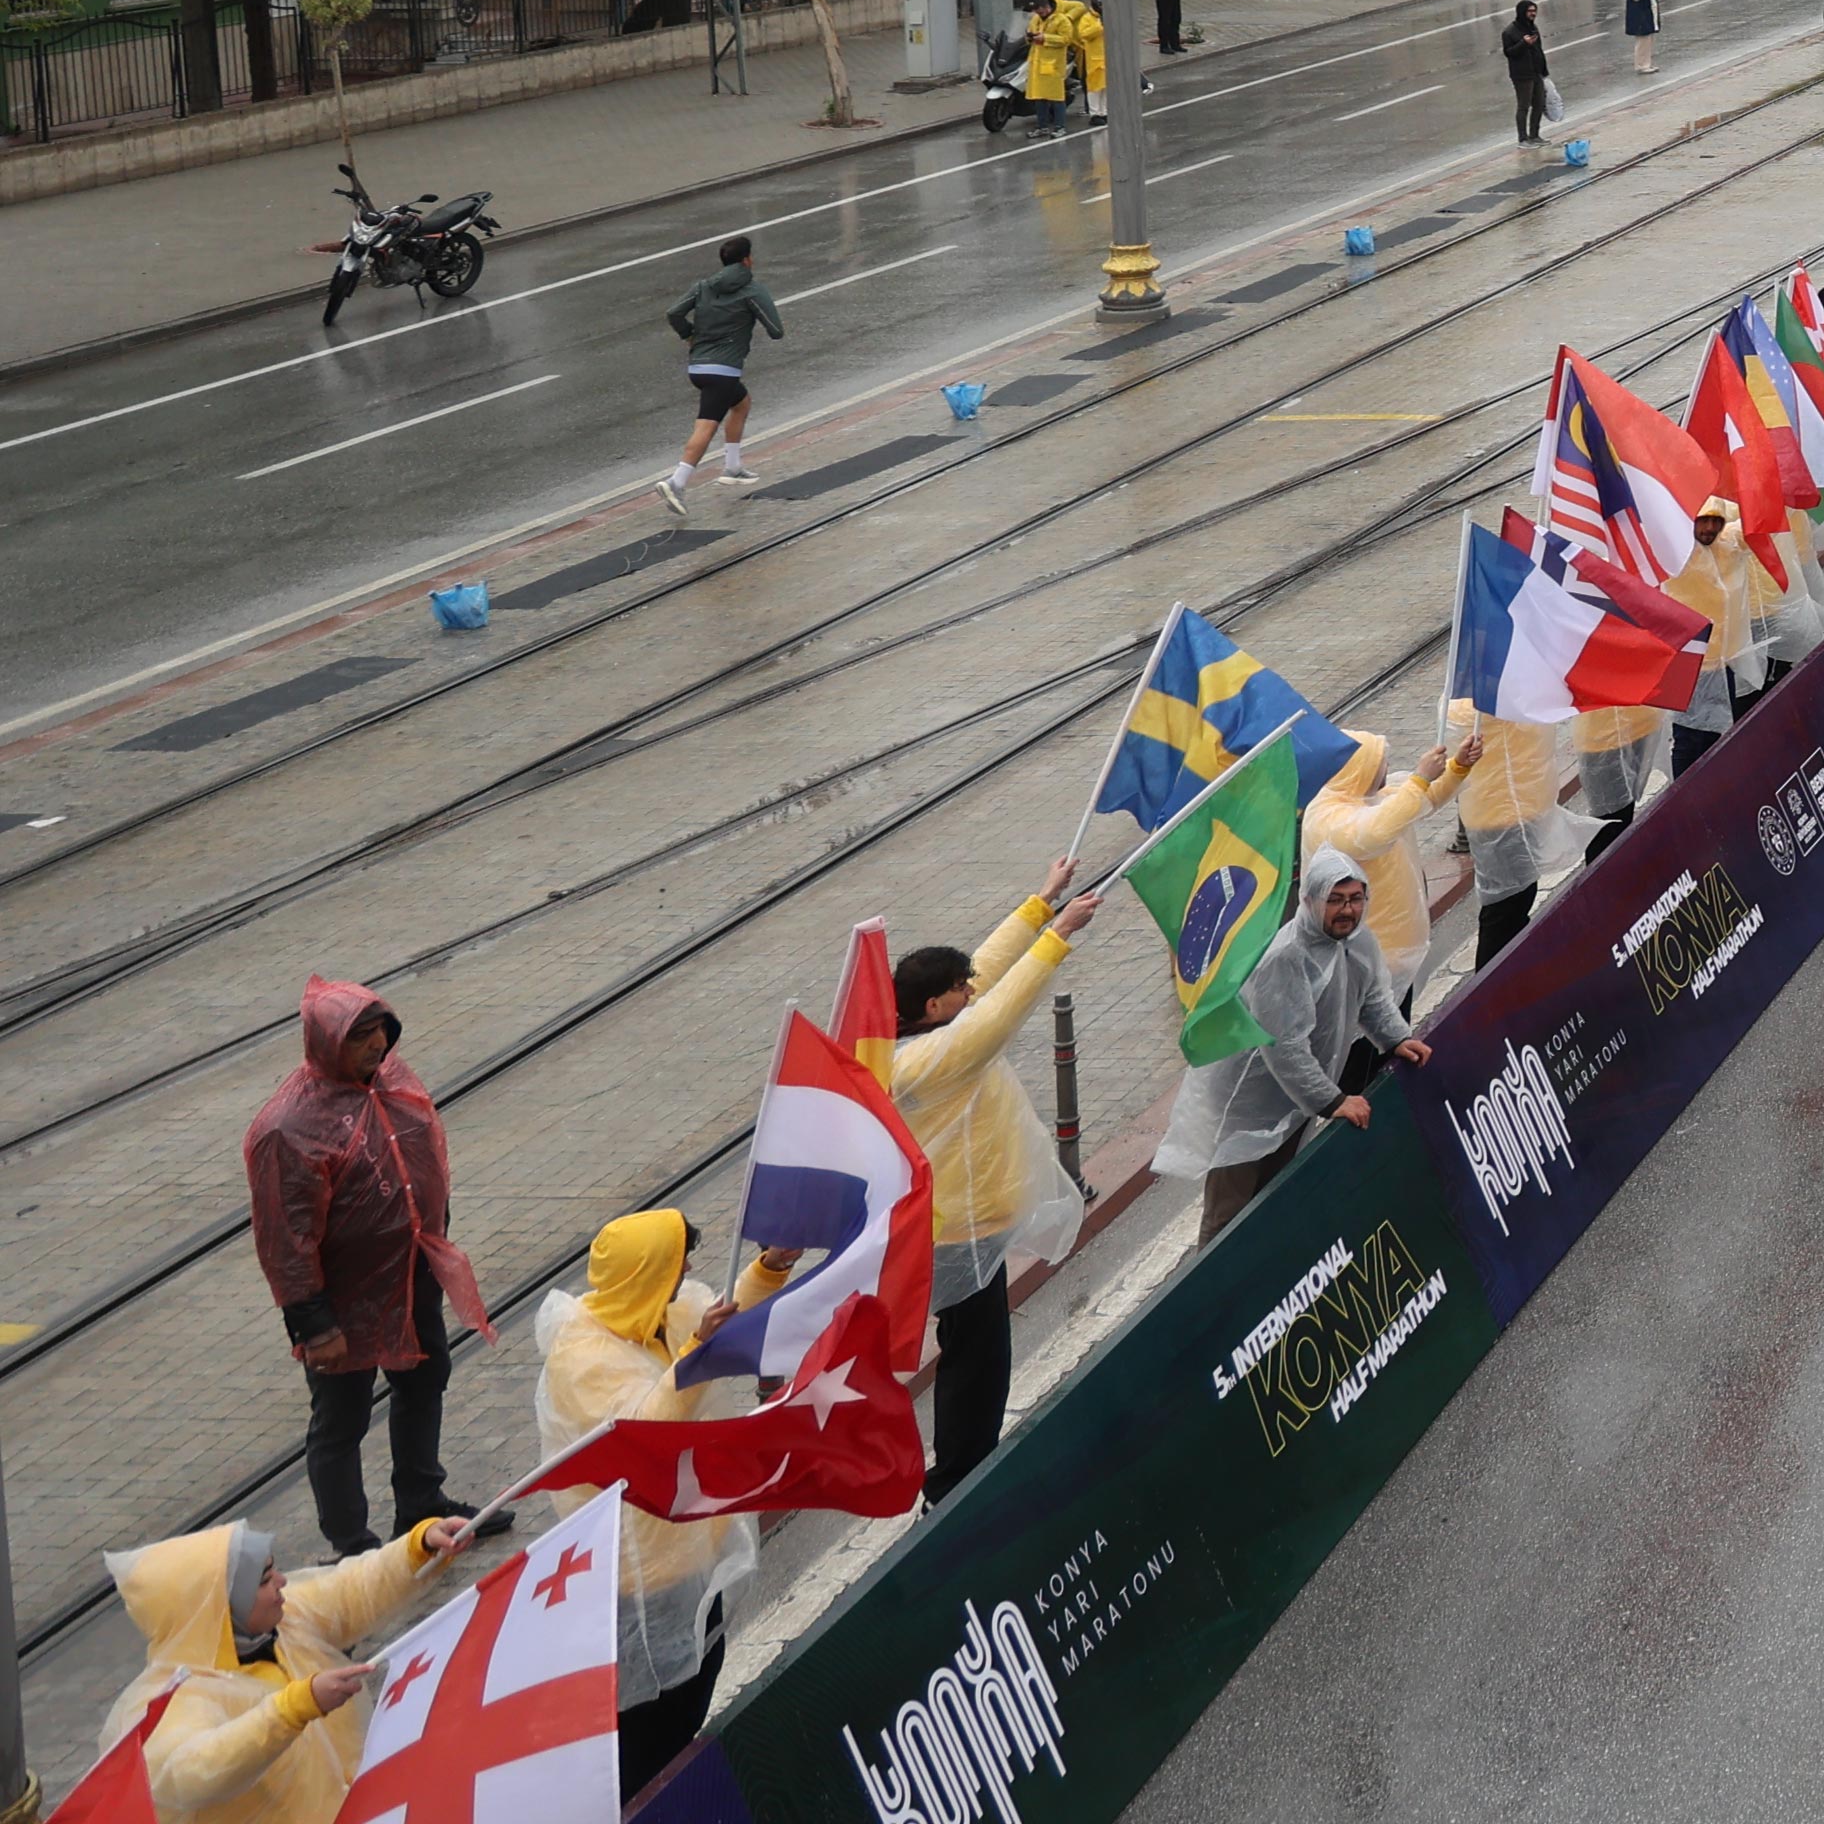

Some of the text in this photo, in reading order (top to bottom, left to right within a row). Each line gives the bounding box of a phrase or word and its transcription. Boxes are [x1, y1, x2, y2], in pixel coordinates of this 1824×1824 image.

[1622, 868, 1698, 956] INTERNATIONAL
[1633, 861, 1750, 1016] KONYA
[1689, 903, 1765, 1001] HALF MARATHON
[1543, 1010, 1587, 1060] KONYA
[1553, 1043, 1585, 1082] YARI
[1564, 1027, 1629, 1106] MARATONU
[1230, 1236, 1355, 1380] INTERNATIONAL
[1245, 1219, 1427, 1458] KONYA
[1329, 1267, 1449, 1424] HALF MARATHON
[1033, 1528, 1109, 1615] KONYA
[1046, 1579, 1100, 1644] YARI
[1061, 1539, 1176, 1677] MARATONU
